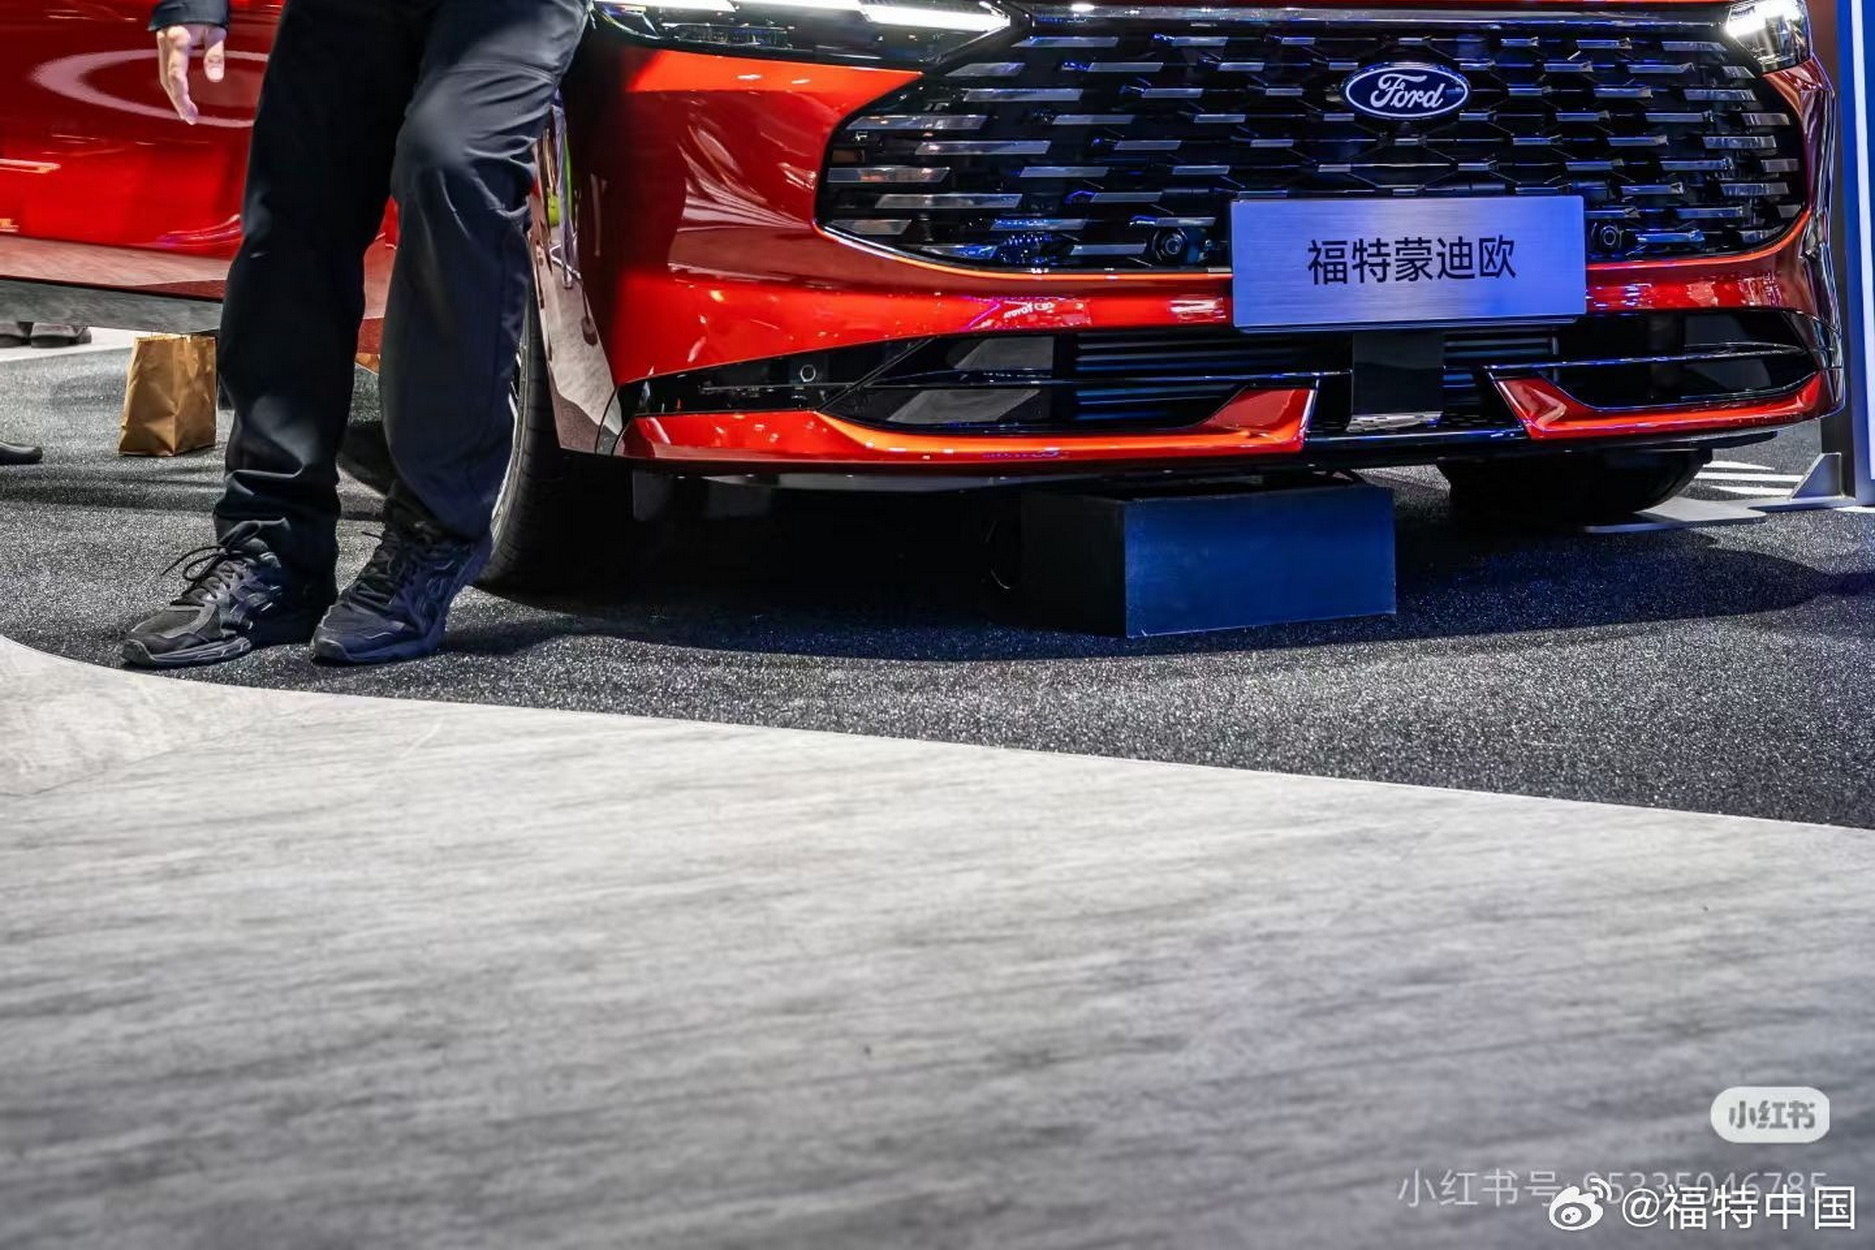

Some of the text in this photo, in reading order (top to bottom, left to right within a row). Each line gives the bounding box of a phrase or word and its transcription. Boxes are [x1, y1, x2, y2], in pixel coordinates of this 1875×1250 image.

[1370, 72, 1444, 109] Ford
[1307, 235, 1517, 286] 福特蒙迪欧
